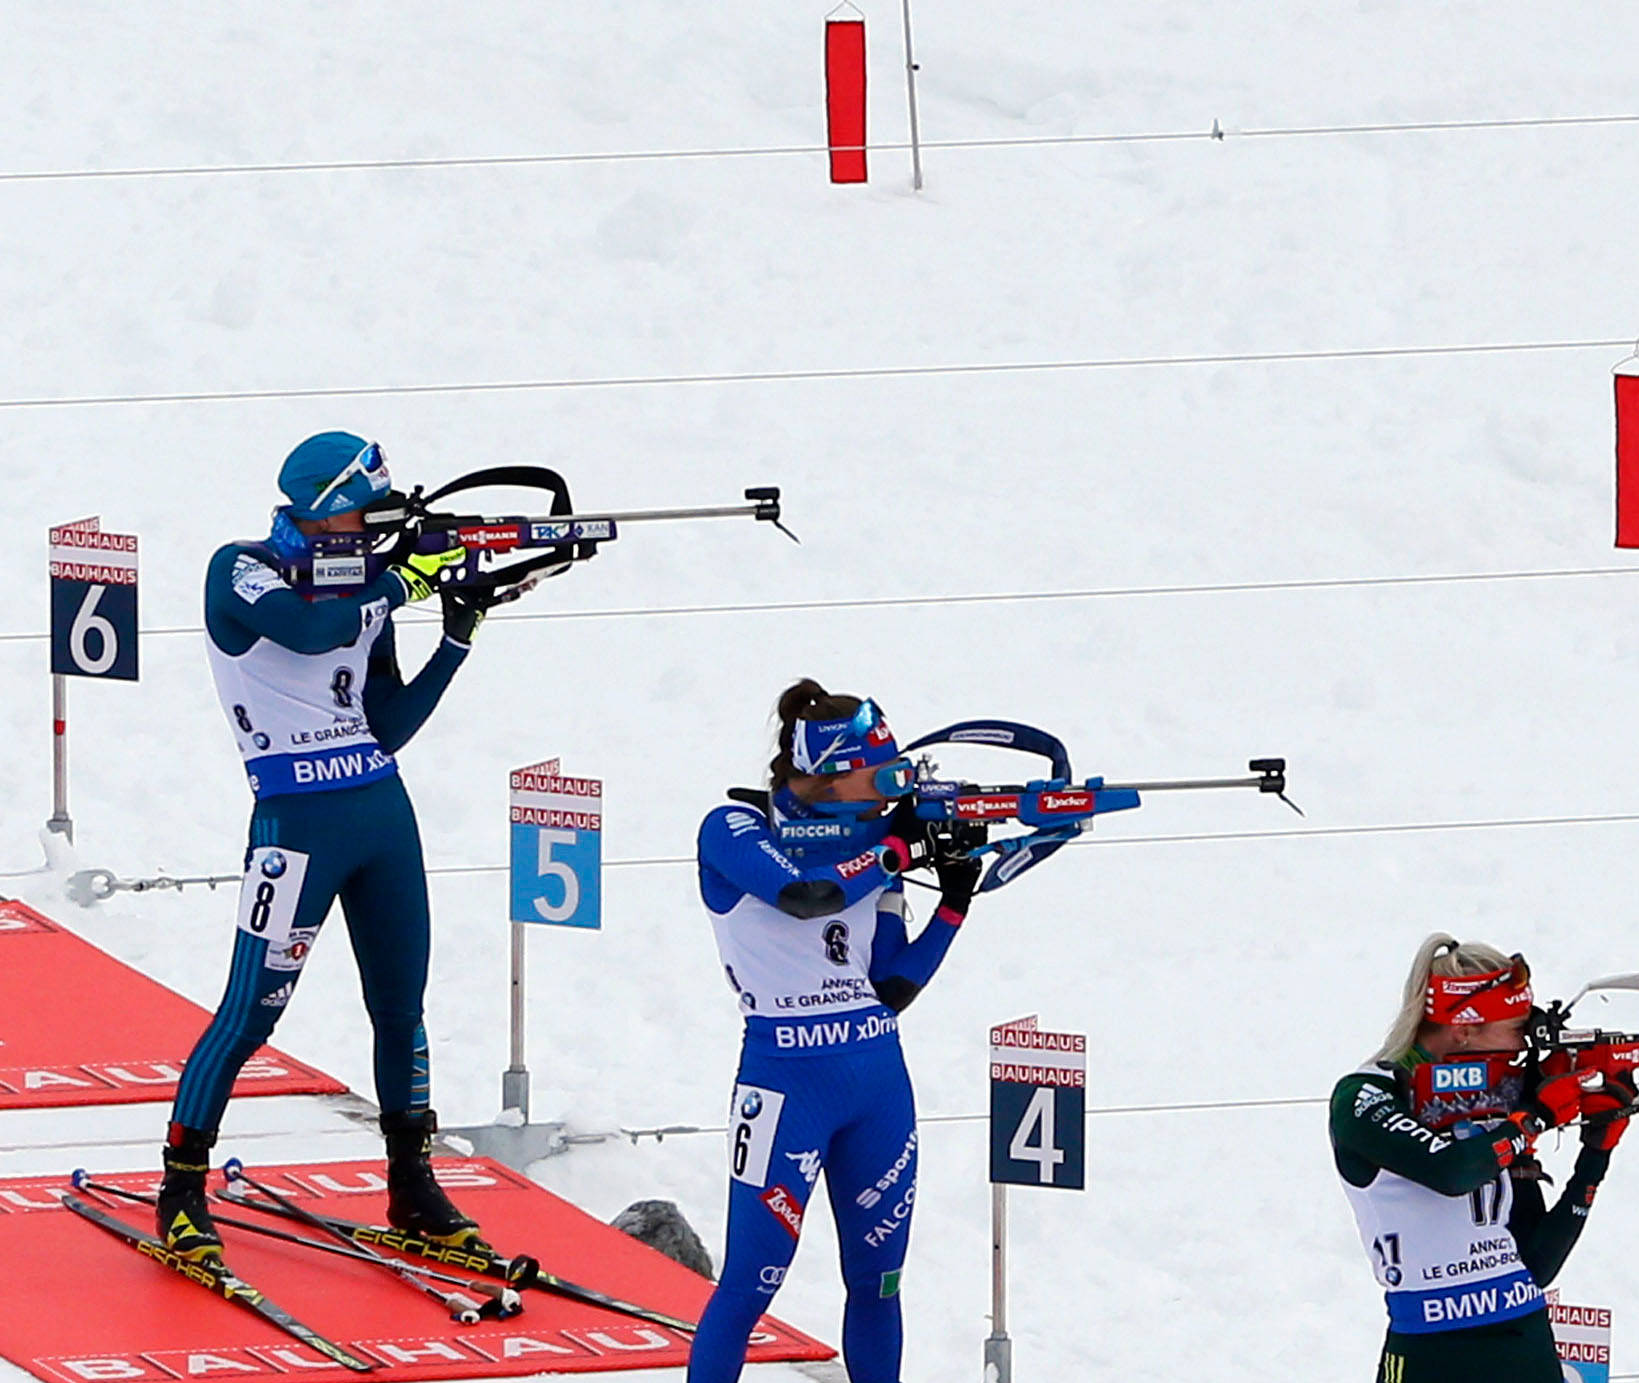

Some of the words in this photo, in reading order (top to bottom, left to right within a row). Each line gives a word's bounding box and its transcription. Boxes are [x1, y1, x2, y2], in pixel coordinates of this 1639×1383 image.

[51, 531, 137, 550] BAUHAUS
[51, 563, 137, 583] BAUHAUS
[71, 585, 117, 674] 6
[233, 704, 253, 733] 8
[291, 732, 310, 745] LE
[294, 753, 363, 784] BMW
[511, 775, 600, 795] BAUHAUS
[1043, 796, 1089, 809] Loacker
[511, 809, 600, 829] BAUHAUS
[782, 825, 841, 838] FIOCCHI
[534, 829, 580, 921] 5
[250, 881, 275, 933] 8
[823, 920, 850, 966] 6
[775, 996, 795, 1009] LE
[775, 1020, 851, 1048] BMW
[856, 1012, 898, 1041] xDri
[992, 1030, 1085, 1050] BAUHAUS
[992, 1065, 1085, 1085] BAUHAUS
[1436, 1067, 1483, 1089] DKB
[1010, 1087, 1065, 1183] 4
[1381, 1112, 1453, 1154] Audi
[734, 1123, 751, 1177] 6
[864, 1179, 917, 1248] FALCO
[352, 1228, 489, 1273] FISCHER
[1373, 1232, 1401, 1267] 17
[136, 1240, 216, 1289] FISCHER
[1422, 1267, 1443, 1281] LE
[1446, 1254, 1522, 1277] GRAND-BO
[1423, 1287, 1499, 1323] BMW
[1503, 1277, 1541, 1310] xDri
[1549, 1309, 1610, 1327] HAUS
[1556, 1344, 1608, 1363] HAUS
